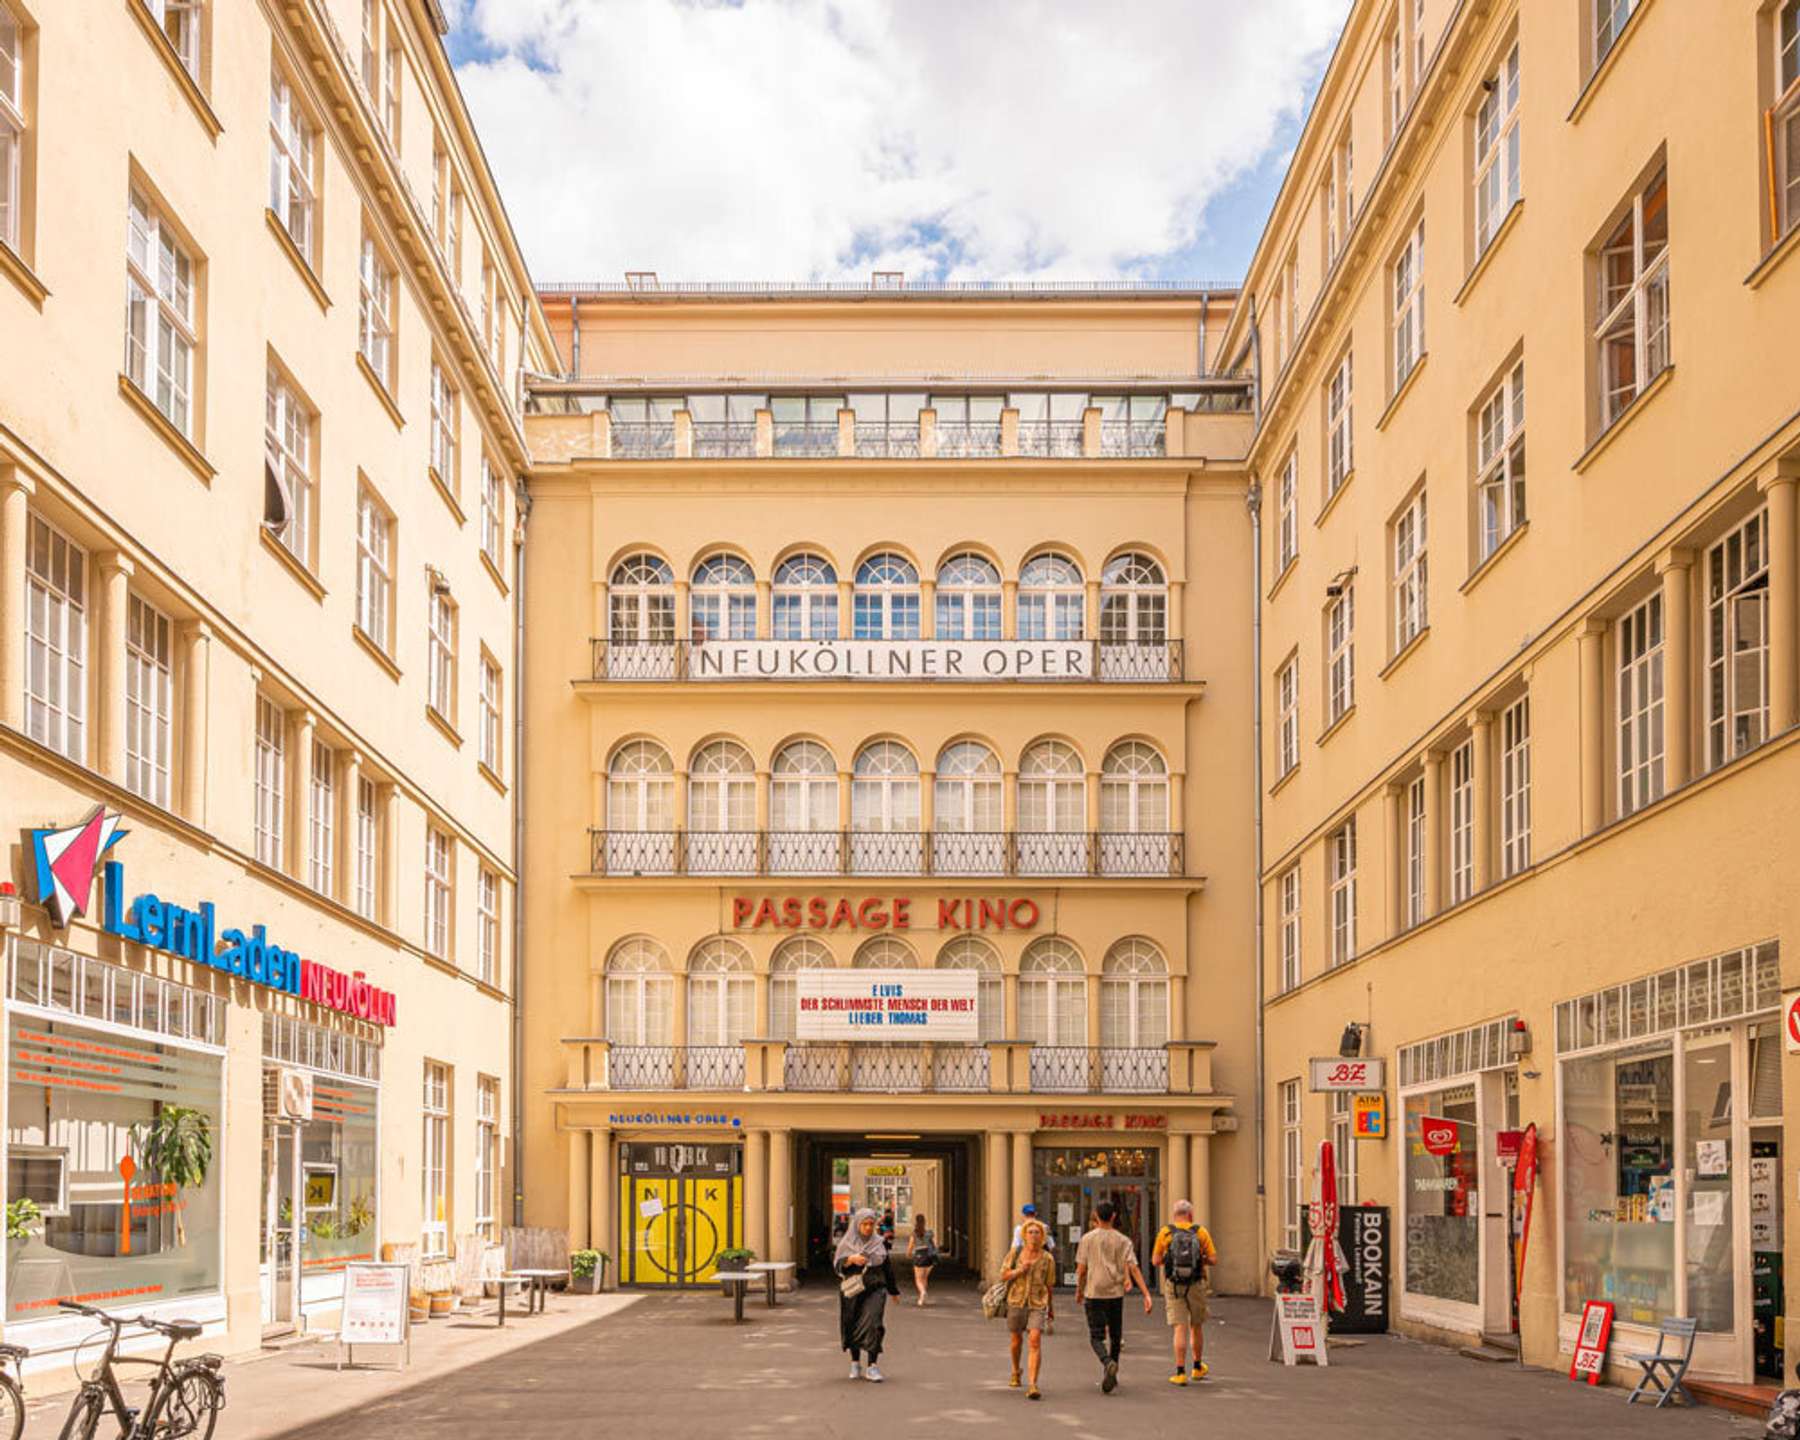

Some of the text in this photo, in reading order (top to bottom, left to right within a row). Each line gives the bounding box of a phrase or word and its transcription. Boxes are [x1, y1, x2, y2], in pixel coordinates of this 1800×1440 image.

[983, 648, 1083, 675] OPER
[733, 896, 1040, 929] PASSAGE KINO
[105, 861, 396, 1027] LernLaden NEUKÖLLN
[872, 984, 903, 997] ELVIS
[800, 998, 974, 1012] DER SCHLIMMSTE MENSCH DER WELT
[848, 1012, 928, 1025] LIEBER THOMAS
[1358, 1096, 1381, 1105] ATM
[1358, 1111, 1381, 1133] EC
[705, 1187, 718, 1201] K
[1363, 1212, 1383, 1315] BOOKAIN
